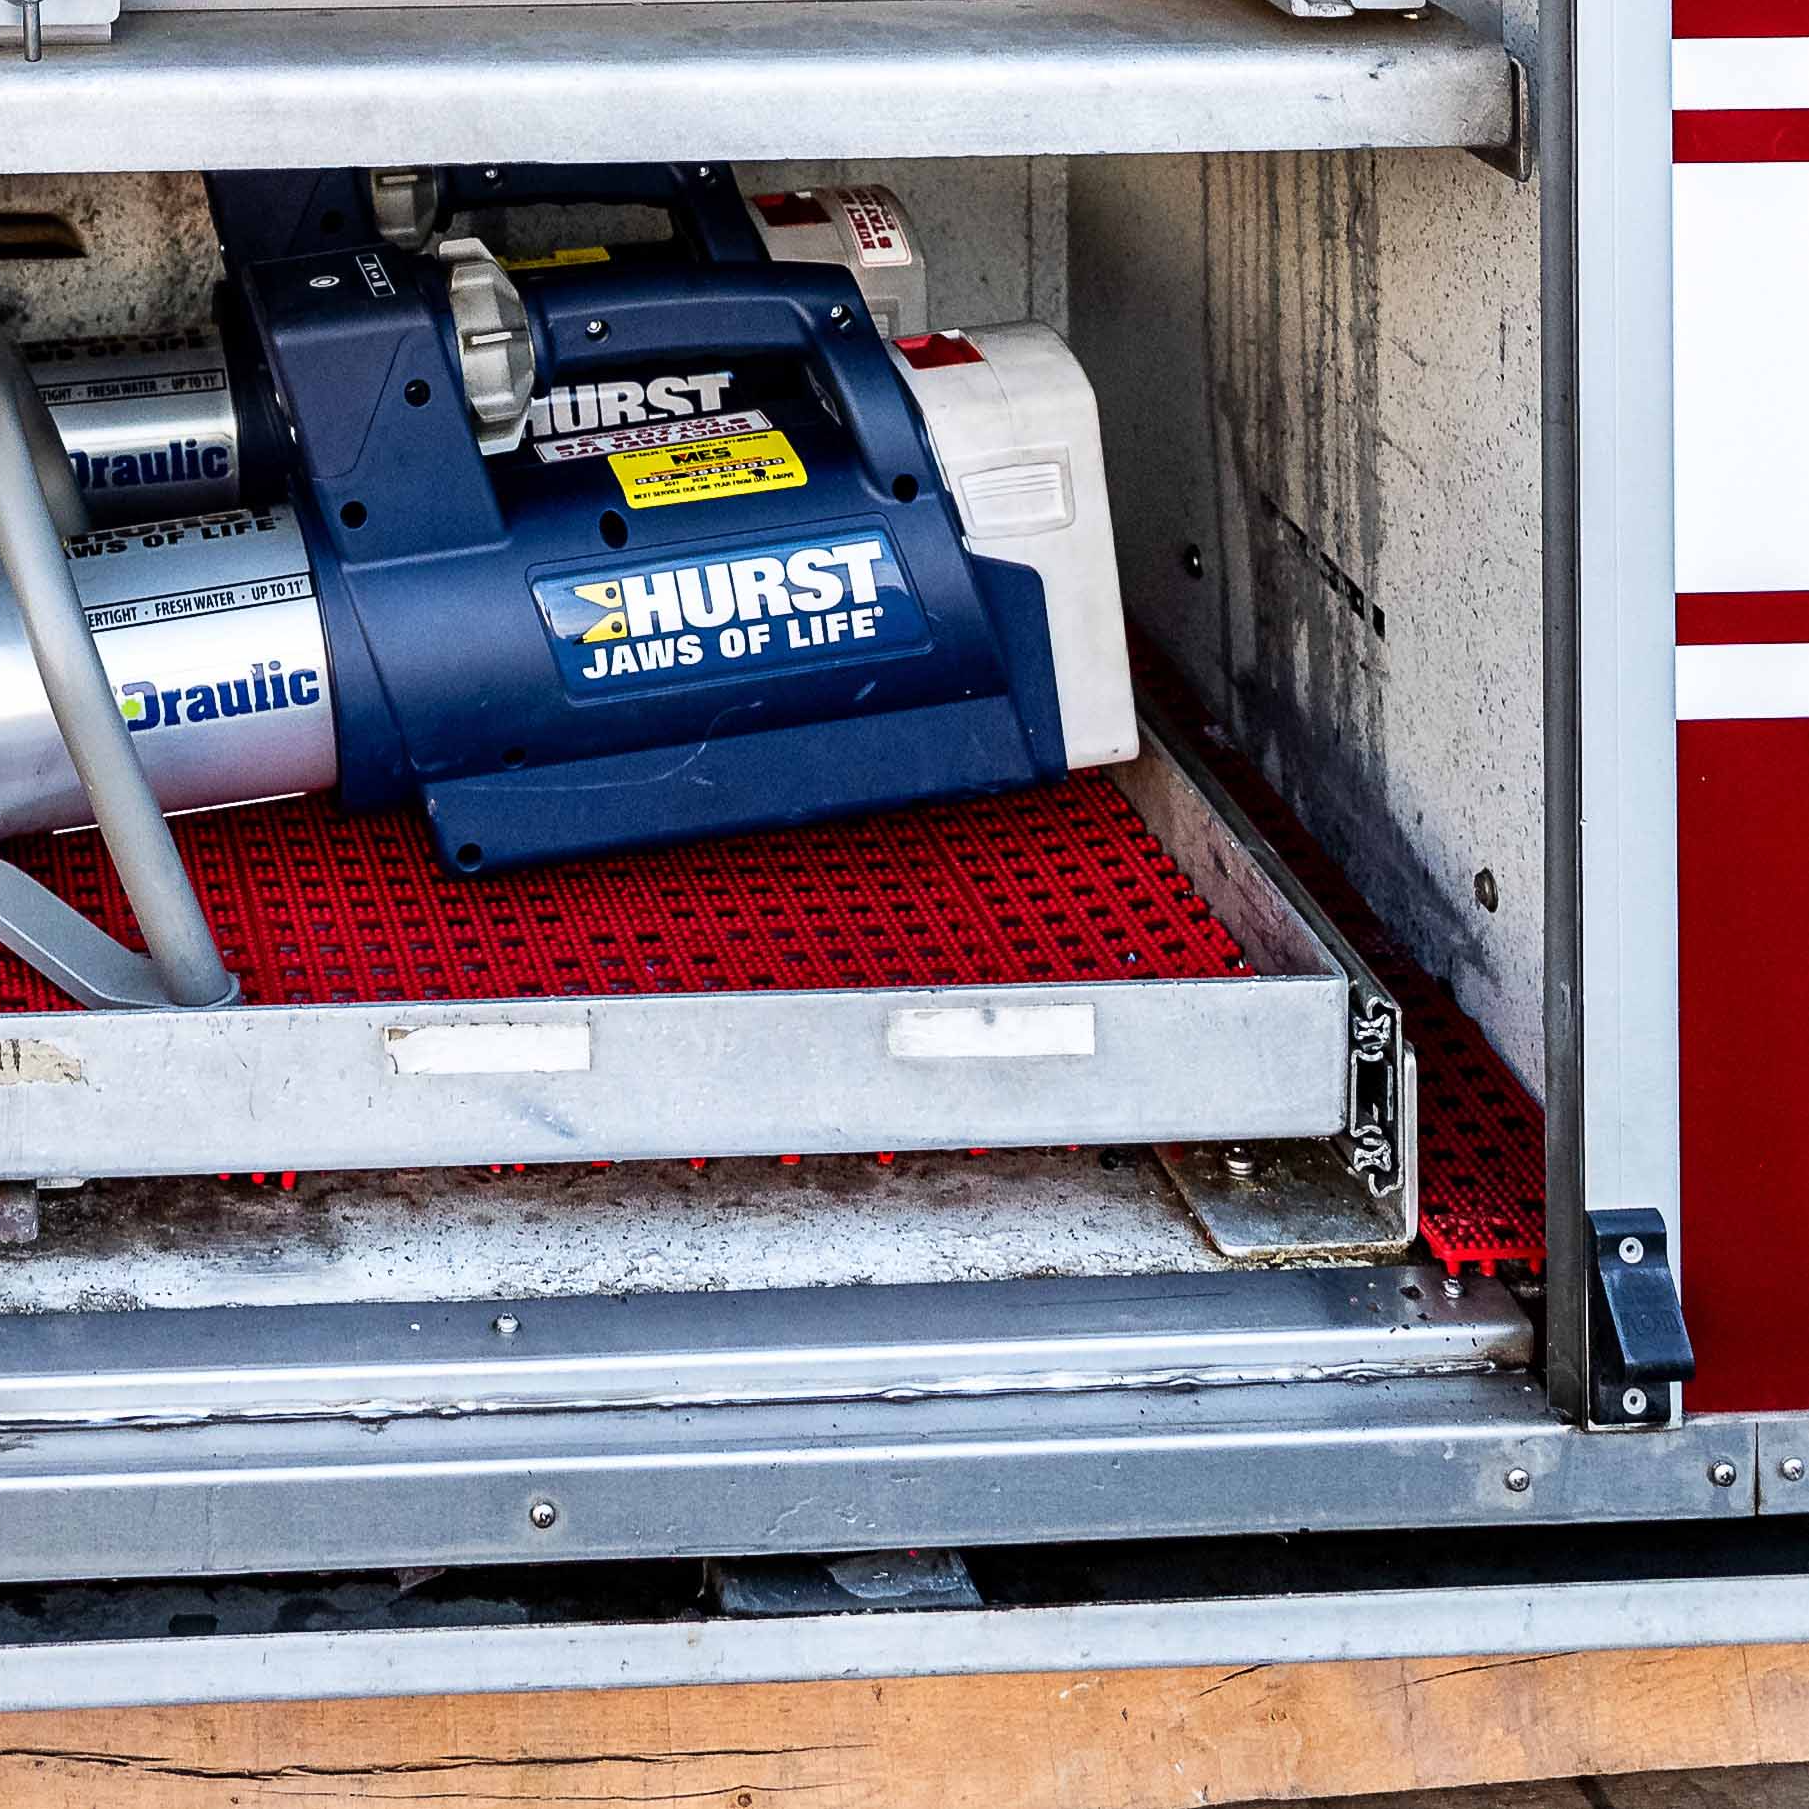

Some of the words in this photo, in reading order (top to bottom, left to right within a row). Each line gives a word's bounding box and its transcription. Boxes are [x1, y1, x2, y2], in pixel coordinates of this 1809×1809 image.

[39, 388, 72, 402] TIGHT
[87, 383, 119, 398] FRESH
[121, 379, 157, 394] WATER
[172, 377, 187, 390] UP
[188, 376, 202, 388] TO
[68, 439, 229, 488] Draulic
[671, 447, 732, 466] MES
[64, 539, 129, 560] WS
[141, 530, 186, 548] OF
[202, 518, 277, 541] LIFE
[155, 598, 193, 618] FRESH
[194, 590, 236, 610] WATER
[252, 585, 271, 601] UP
[270, 582, 287, 598] TO
[621, 540, 884, 637] HURST
[582, 635, 704, 679] JAWS
[719, 623, 771, 658] OF
[122, 660, 320, 732] Draulic
